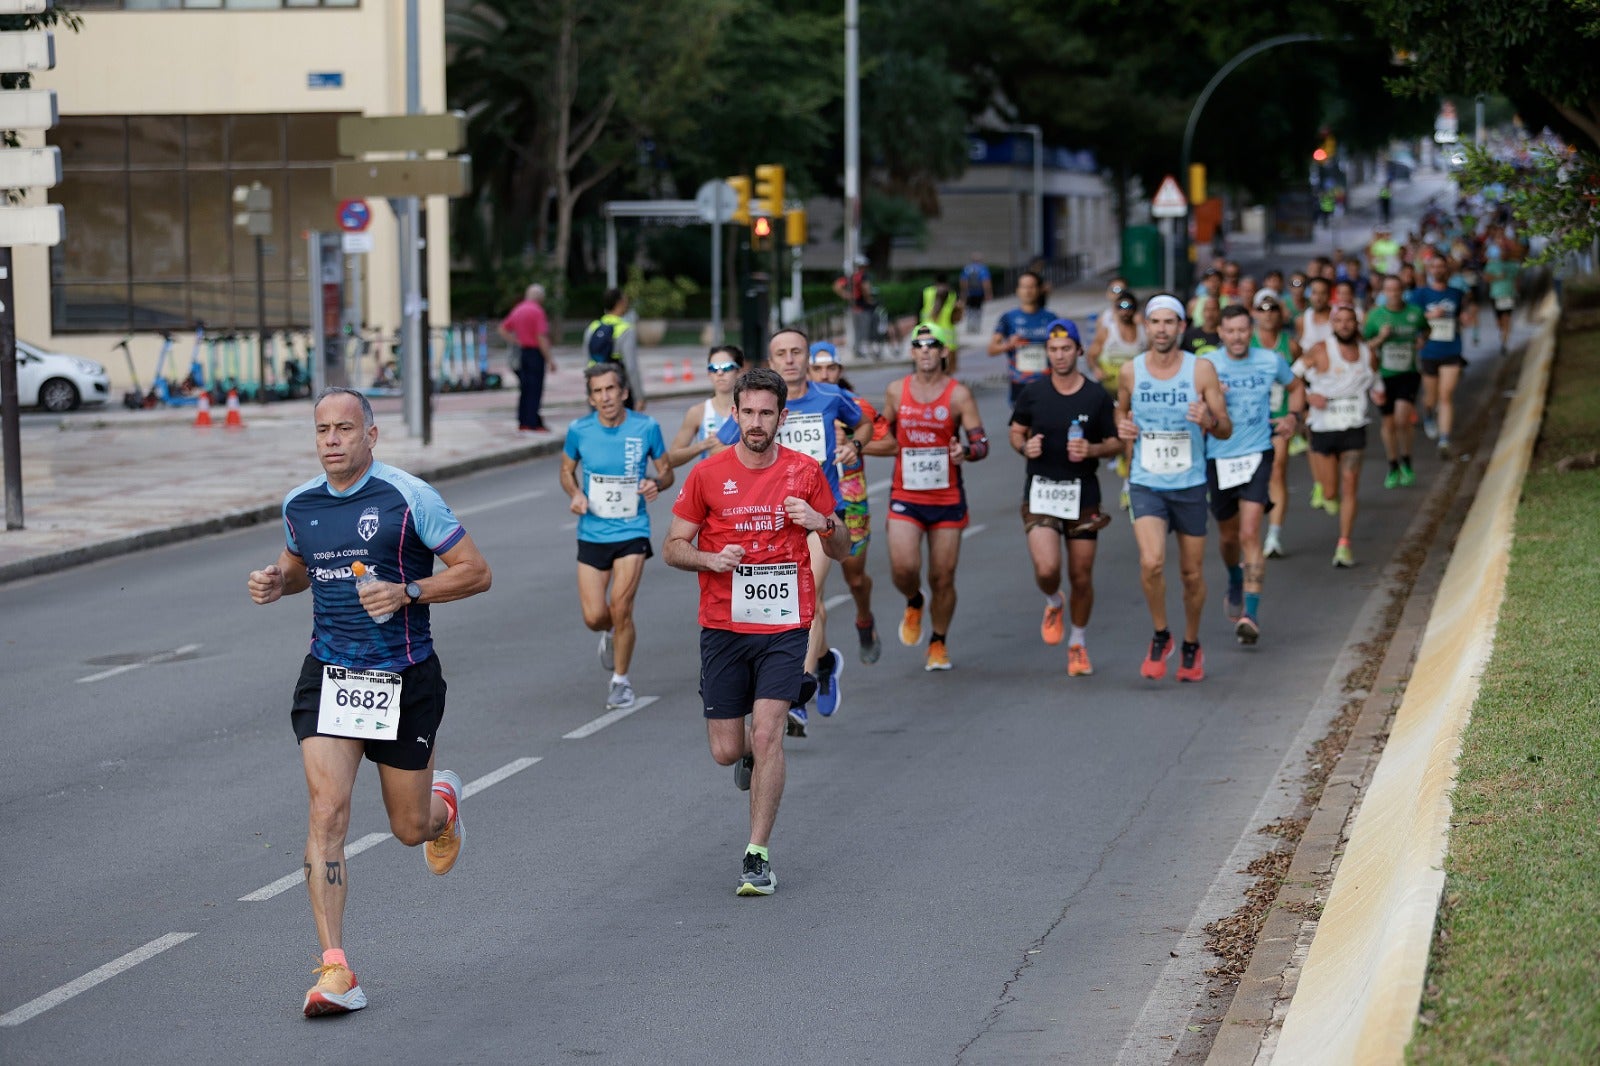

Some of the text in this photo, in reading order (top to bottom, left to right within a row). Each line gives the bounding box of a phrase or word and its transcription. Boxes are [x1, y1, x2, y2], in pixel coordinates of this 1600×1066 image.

[1141, 388, 1188, 406] nerja
[776, 429, 821, 443] 11053
[1156, 446, 1179, 458] 110
[606, 491, 622, 502] 23
[733, 505, 771, 514] GENERALI
[343, 549, 369, 557] CORRER
[736, 566, 752, 576] 43
[744, 583, 789, 600] 9605
[336, 689, 389, 709] 6682
